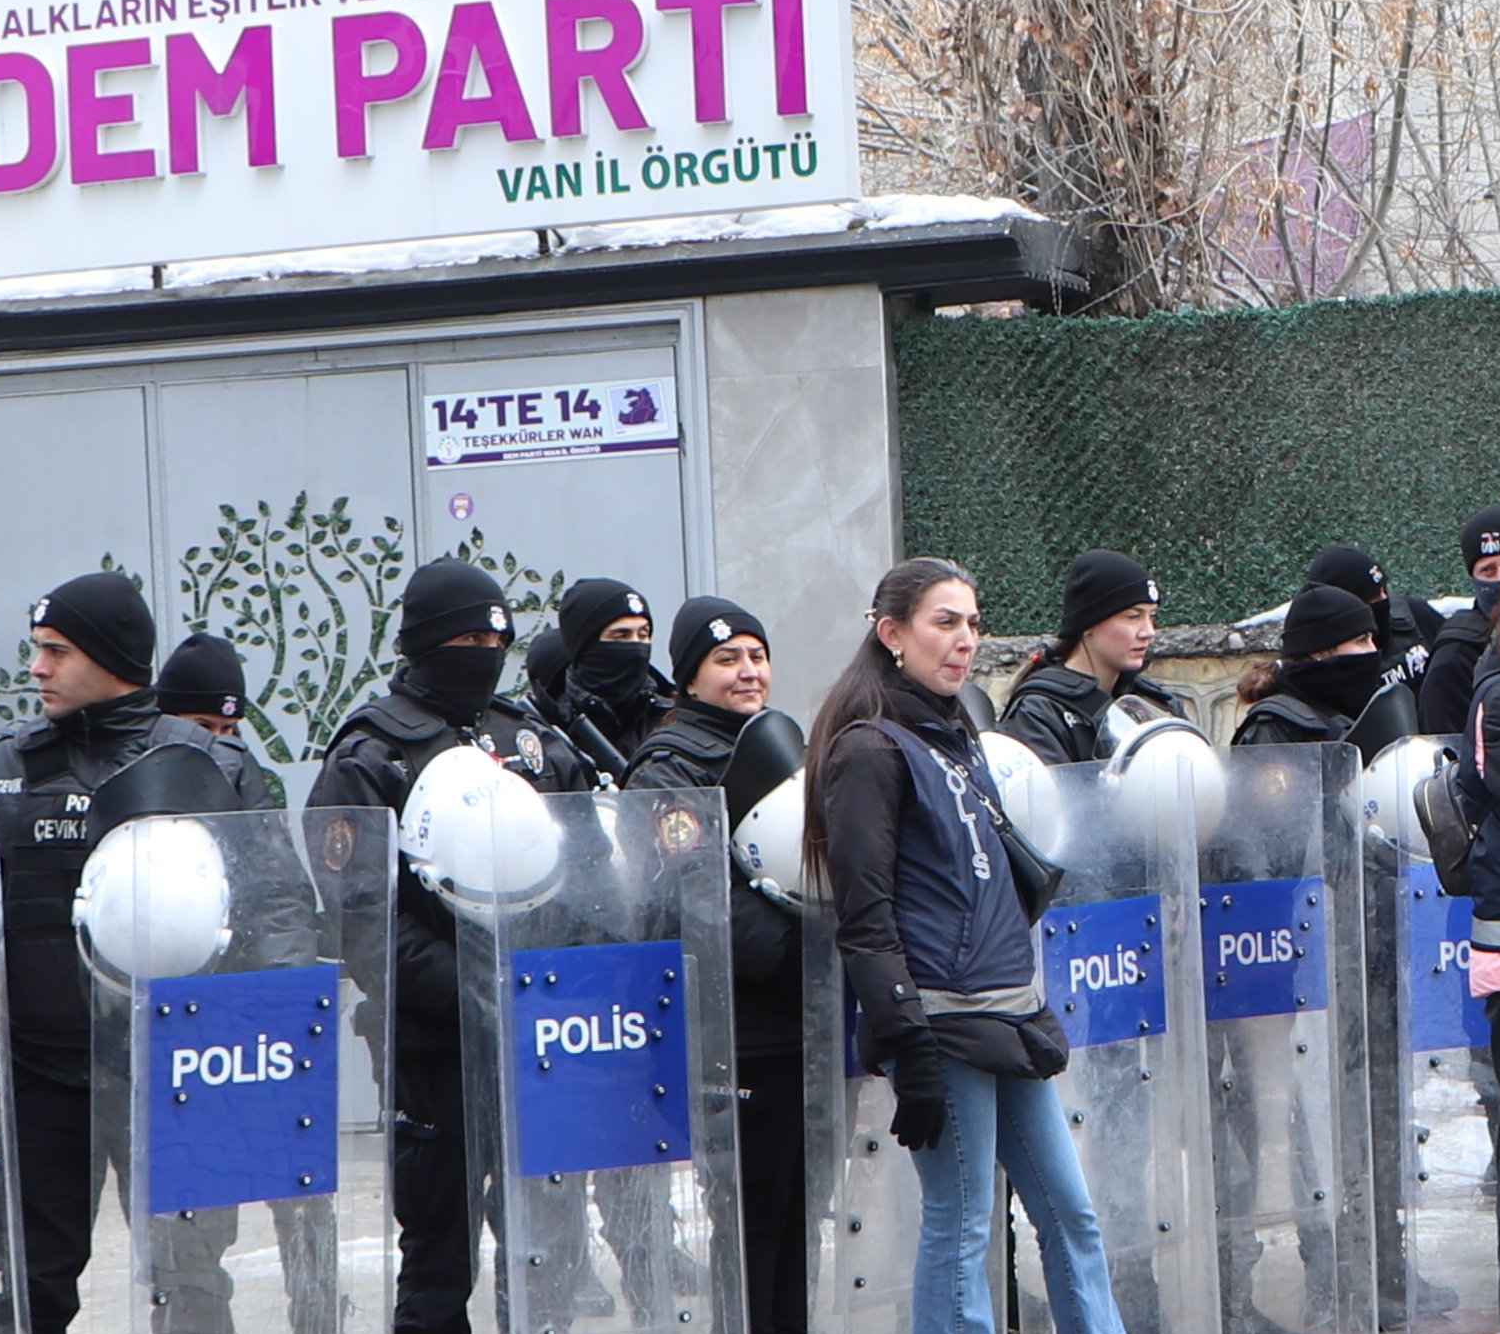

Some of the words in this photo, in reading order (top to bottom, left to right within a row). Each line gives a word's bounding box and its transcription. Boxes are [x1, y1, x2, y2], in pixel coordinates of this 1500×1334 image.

[497, 162, 582, 203] VAN
[595, 150, 631, 195] İL
[641, 131, 818, 190] ÖRGÜTÜ
[432, 392, 543, 432] 14'TE
[555, 388, 602, 422] 14
[463, 428, 566, 450] TEŞEKKÜRLER
[570, 426, 604, 440] WAN
[34, 819, 79, 842] ÇEVİK
[1069, 944, 1139, 994] POLİS
[1219, 928, 1293, 967] POLİS
[535, 1004, 648, 1056] POLİS
[172, 1033, 295, 1088] POLİS
